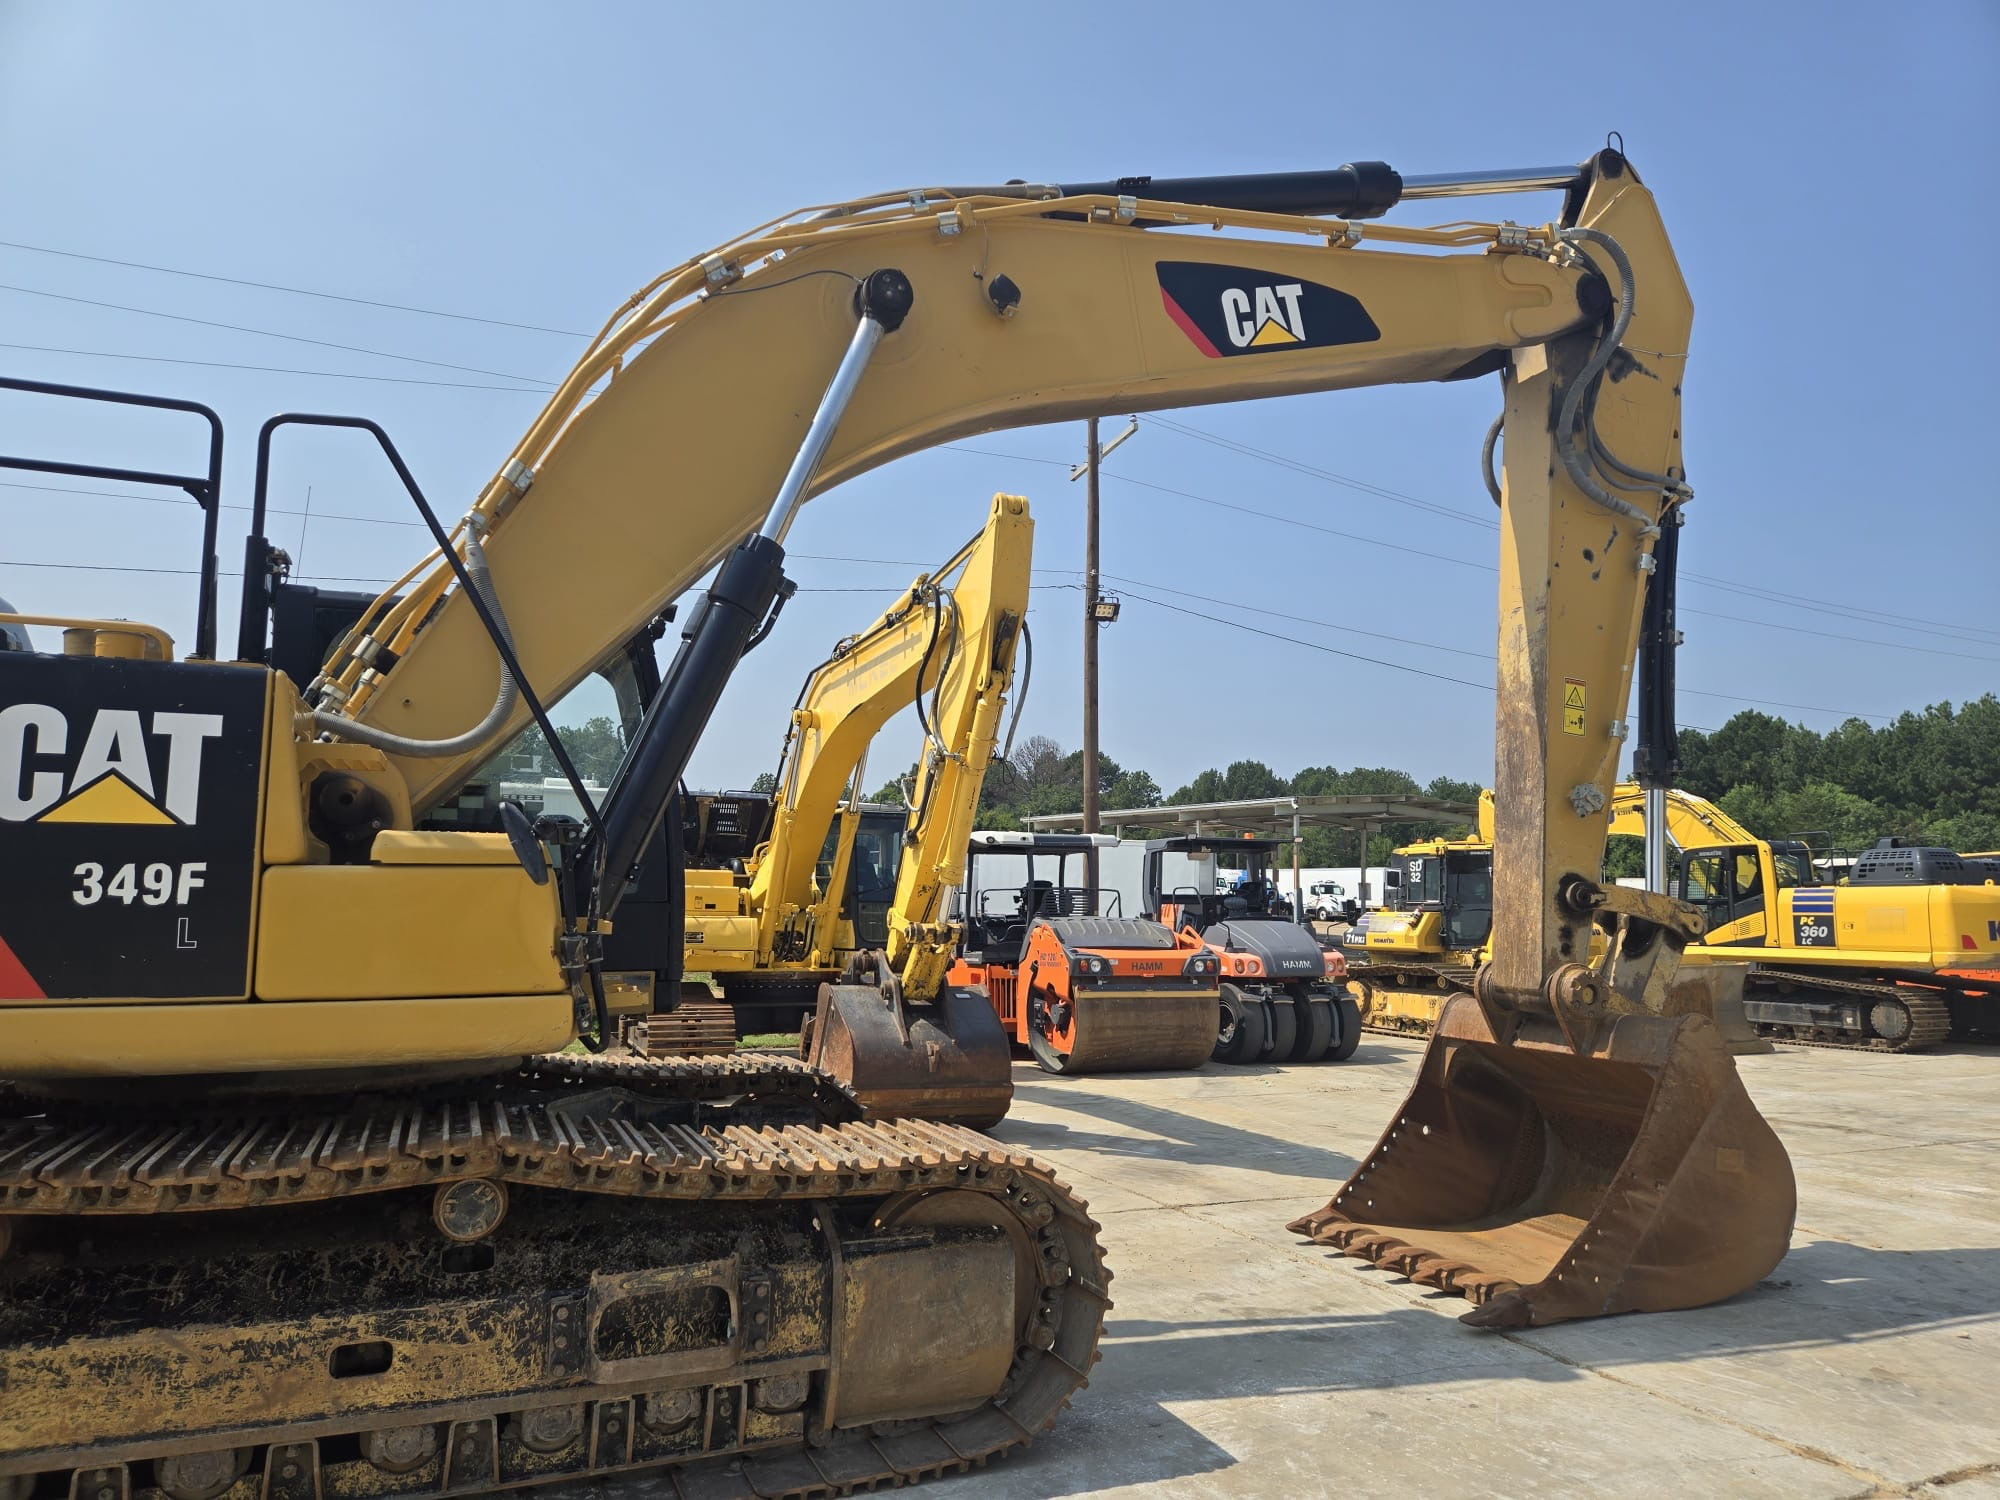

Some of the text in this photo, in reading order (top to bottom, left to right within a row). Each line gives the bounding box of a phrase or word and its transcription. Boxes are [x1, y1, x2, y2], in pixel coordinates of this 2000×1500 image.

[1221, 283, 1306, 348] CAT
[0, 703, 224, 826] CAT
[1409, 860, 1423, 872] SD
[1410, 872, 1421, 882] 32
[72, 862, 207, 906] 349F
[1800, 916, 1815, 925] PC
[176, 917, 198, 949] L
[1800, 926, 1828, 937] 360
[1801, 937, 1813, 945] LC
[1131, 961, 1164, 971] HAMM
[1282, 960, 1312, 969] HAMM
